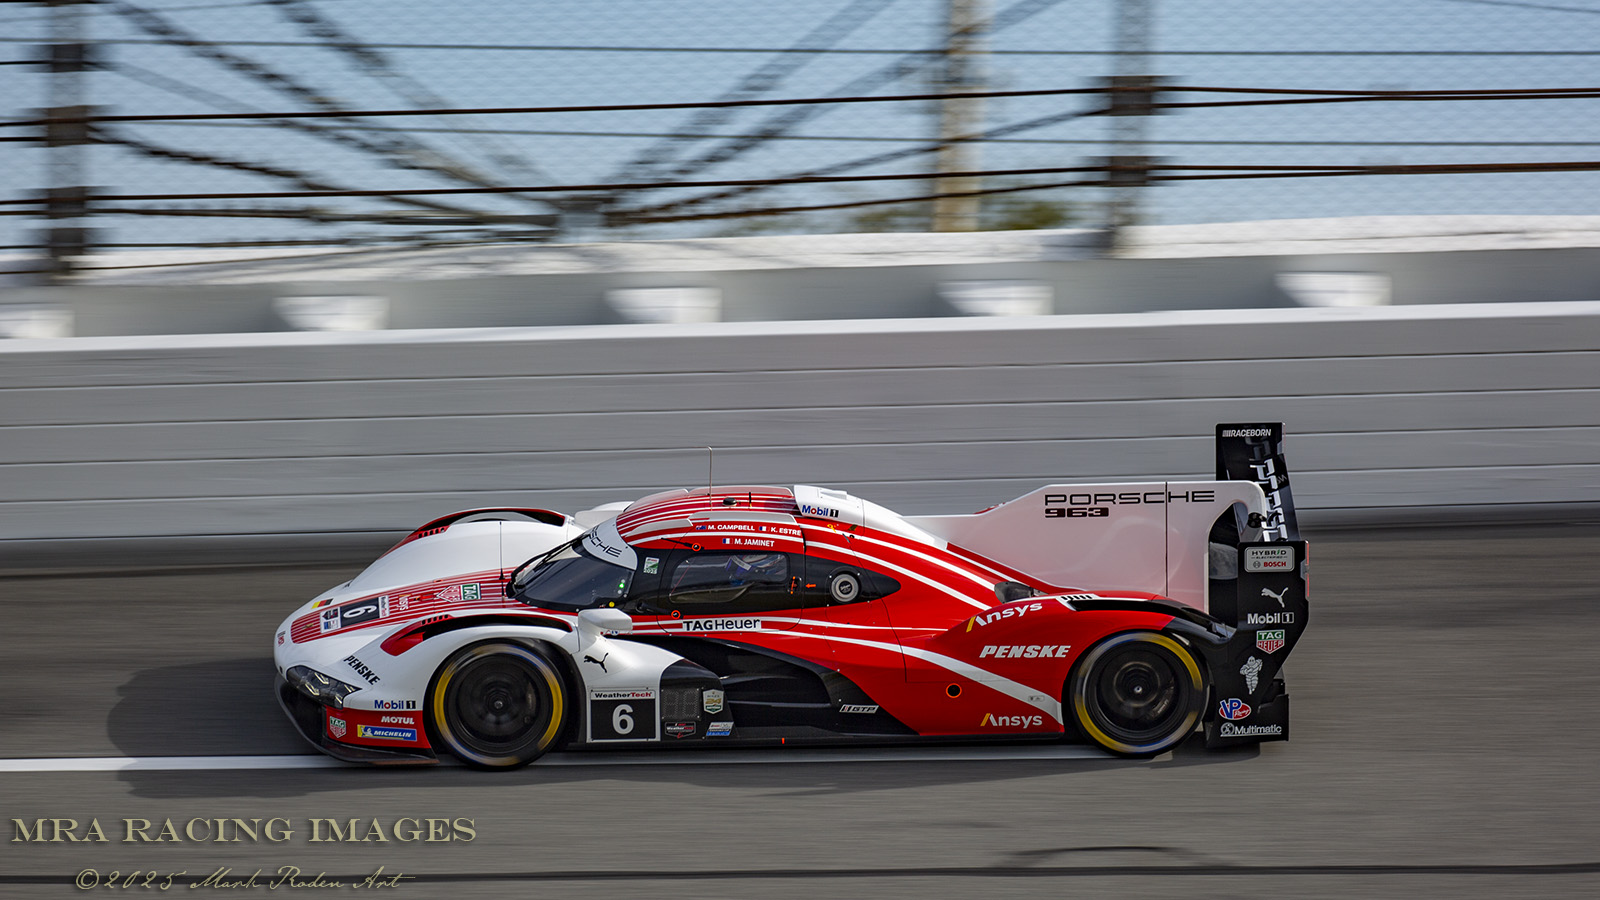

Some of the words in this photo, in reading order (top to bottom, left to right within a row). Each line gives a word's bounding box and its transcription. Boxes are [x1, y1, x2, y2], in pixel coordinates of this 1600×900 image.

[1231, 429, 1272, 437] RACEBORN
[1044, 490, 1215, 506] PORSCHE
[801, 504, 829, 516] Mobil
[1044, 507, 1109, 518] 963
[779, 528, 801, 536] ESTRE
[743, 538, 775, 547] JAMINET
[966, 602, 1043, 633] Ansys
[1247, 612, 1280, 625] Mobil
[1259, 631, 1282, 640] TAG
[979, 645, 1071, 659] PENSKE
[1257, 640, 1284, 652] HEUER
[343, 655, 380, 685] PENSKE
[374, 700, 404, 710] Mobil
[1220, 698, 1242, 719] VP
[381, 715, 415, 725] MOTUL
[612, 703, 634, 735] 6
[980, 713, 1043, 729] Ansys
[373, 730, 412, 738] MICHELIN
[1234, 724, 1282, 735] Multimatic
